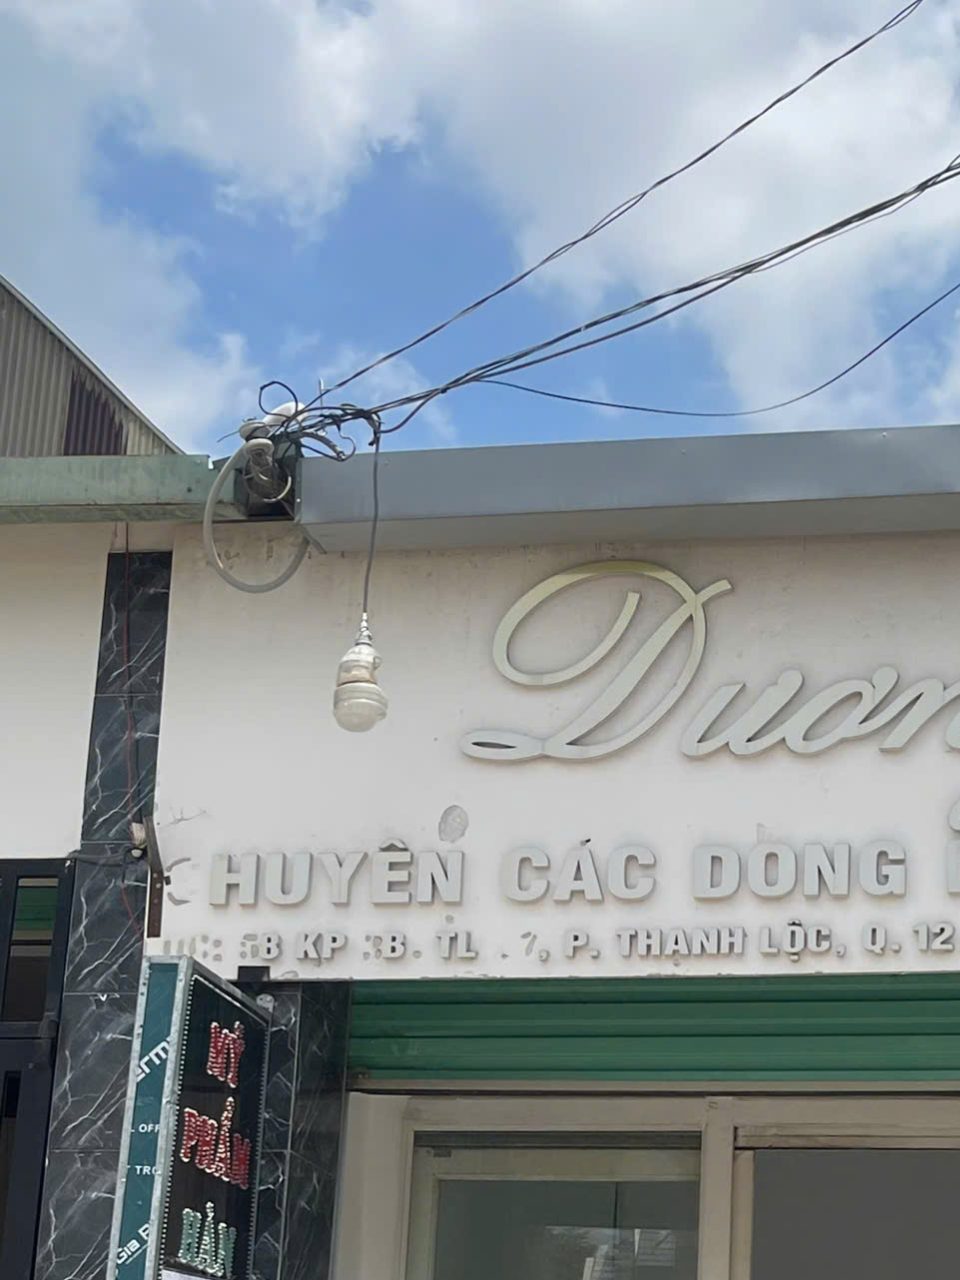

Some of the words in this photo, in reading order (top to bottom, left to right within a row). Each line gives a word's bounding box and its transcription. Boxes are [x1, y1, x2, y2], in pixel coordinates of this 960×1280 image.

[502, 838, 657, 903] CÁC
[296, 930, 347, 961] KP
[435, 930, 477, 959] TL
[563, 928, 600, 957] P.
[864, 921, 902, 955] Q.
